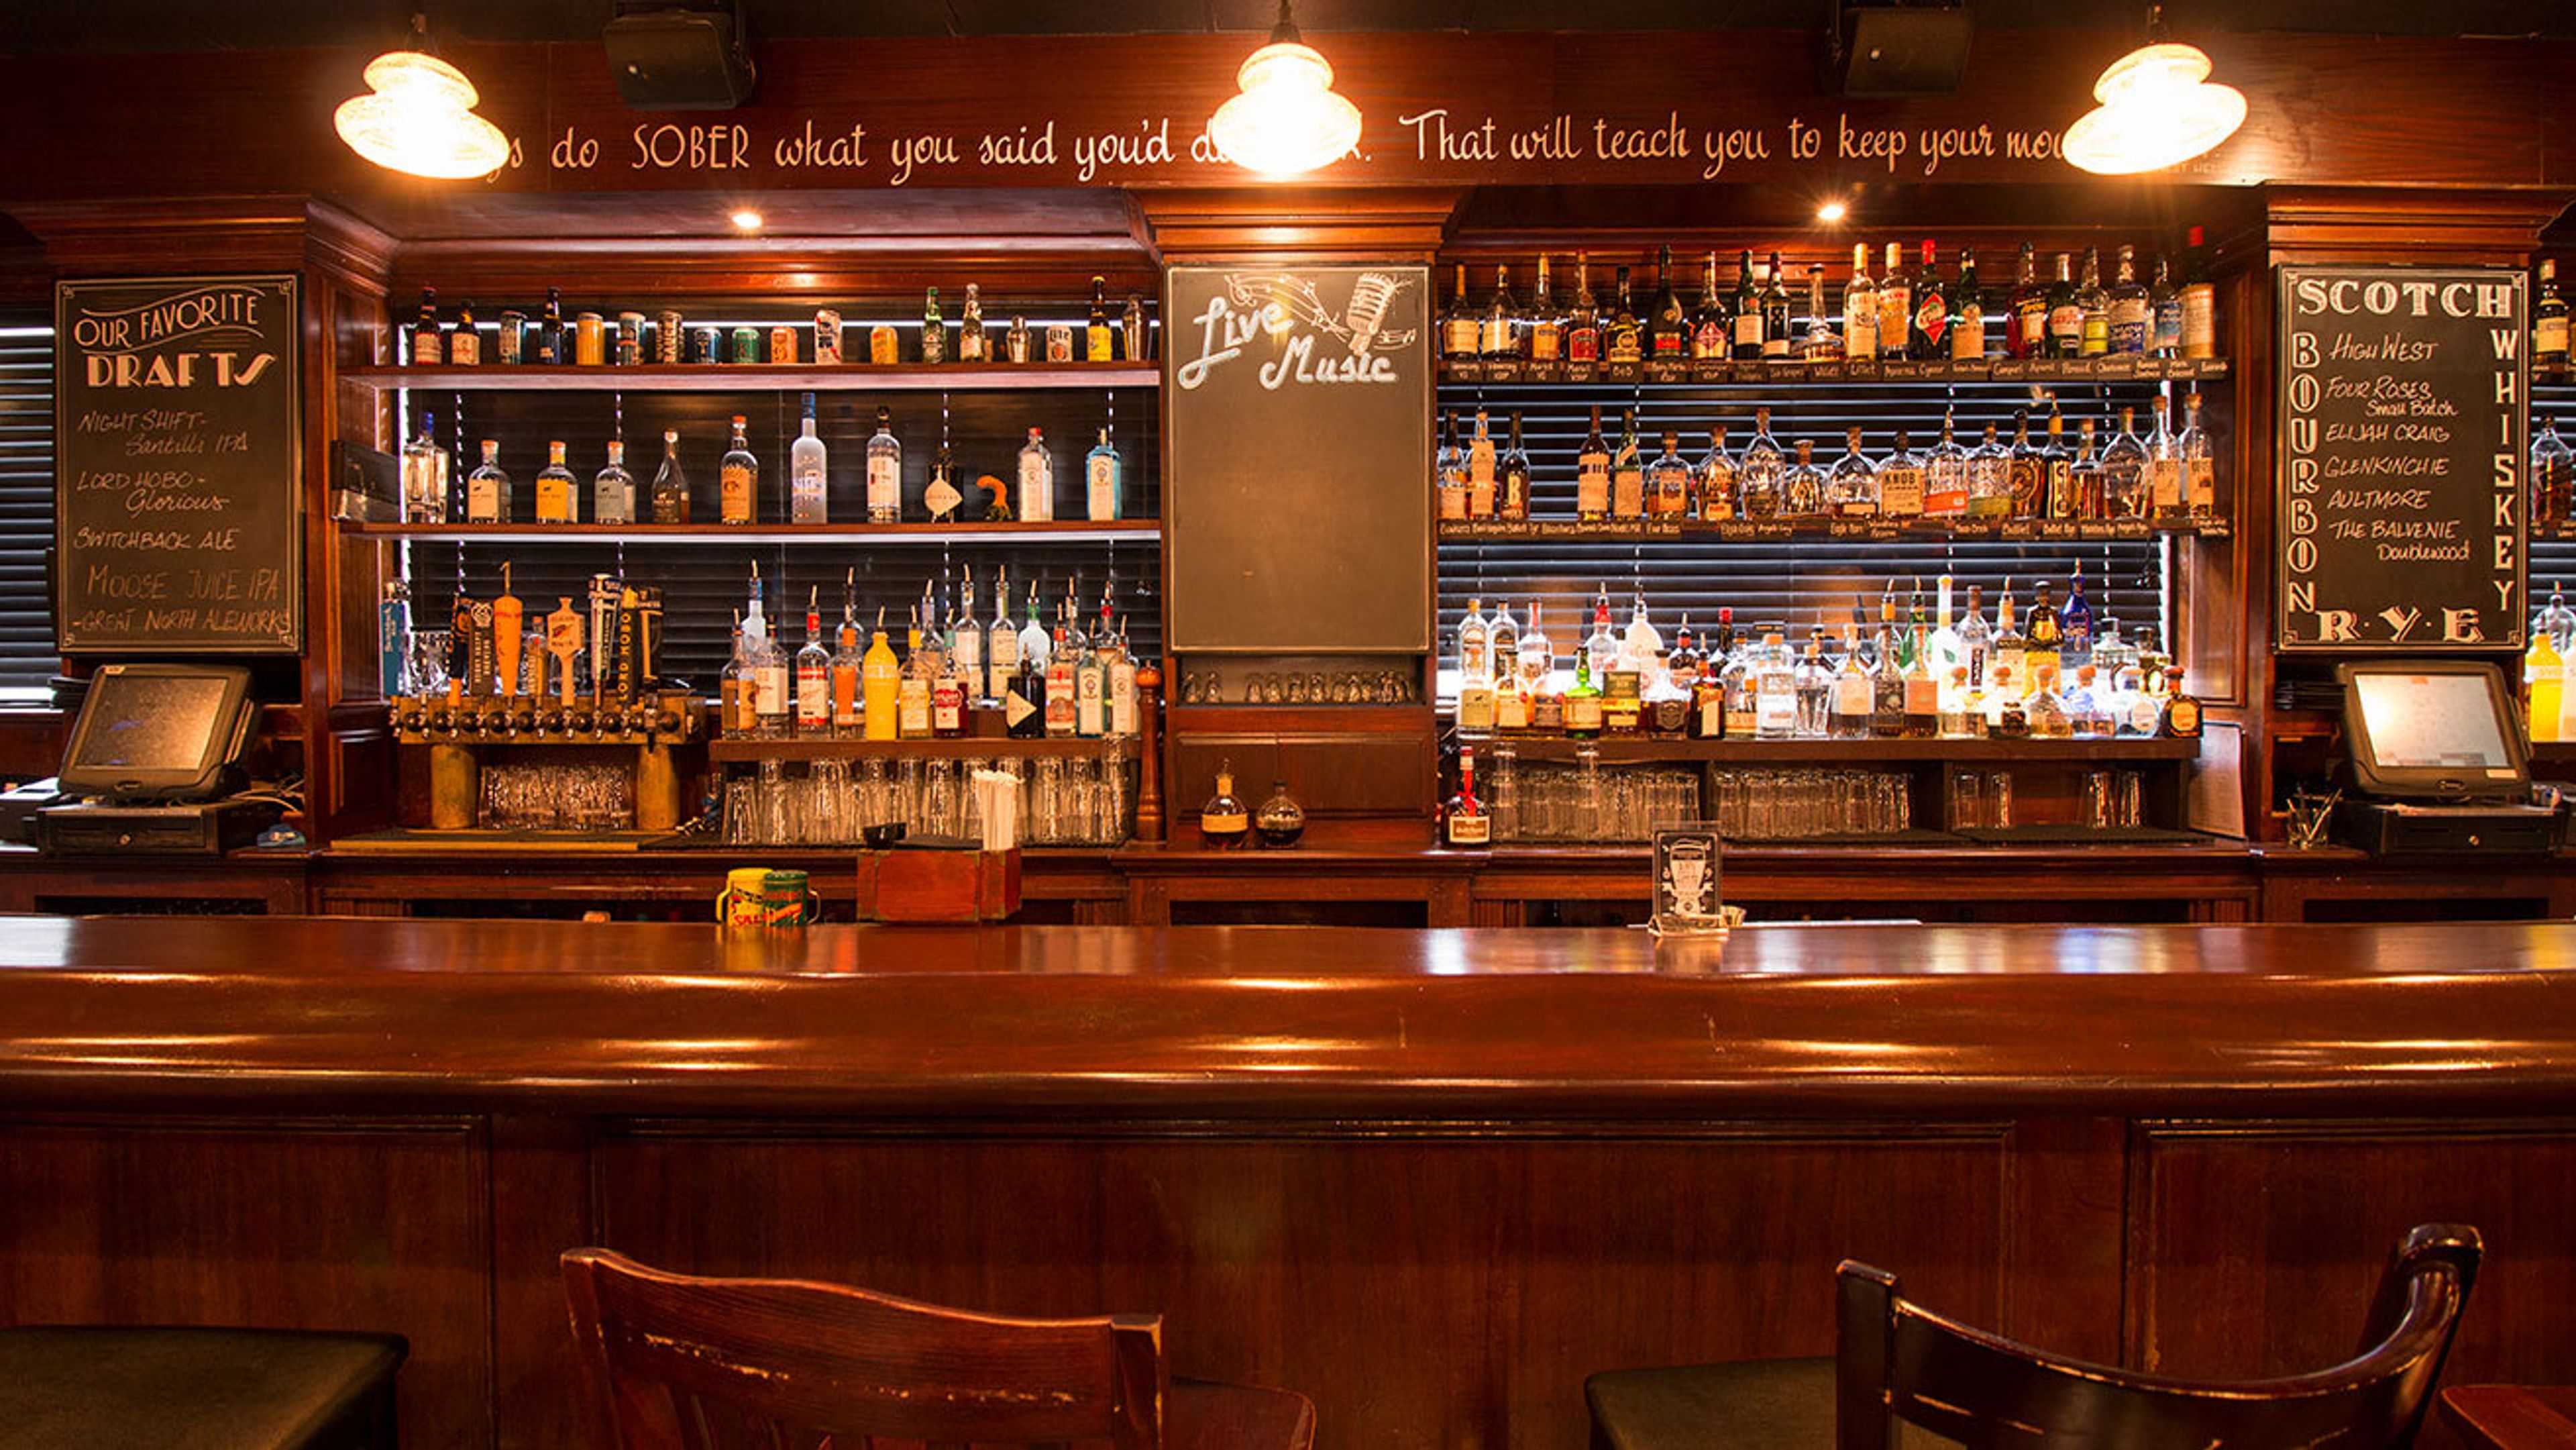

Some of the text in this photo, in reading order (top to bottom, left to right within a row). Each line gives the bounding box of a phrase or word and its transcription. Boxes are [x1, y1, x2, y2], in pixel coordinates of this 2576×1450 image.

[551, 127, 598, 168] do
[632, 124, 749, 168] SOBER
[775, 120, 868, 167] what
[890, 136, 960, 186] you
[979, 121, 1058, 165] said
[1075, 117, 1176, 182] you'd
[1399, 110, 1499, 160] That
[1510, 115, 1582, 160] will
[1594, 111, 1689, 160] teach
[1703, 130, 1769, 179] you
[1788, 117, 1821, 159] to
[1839, 113, 1906, 172] keep
[1921, 124, 1995, 176] your
[2298, 278, 2513, 318] SCOTCH
[74, 294, 258, 348] OUR FAVORITE
[1177, 297, 1295, 390] Live
[2329, 332, 2439, 362] HIGH WEST
[87, 352, 277, 387] DRAFTS
[1259, 334, 1398, 390] Music
[2324, 375, 2433, 401] FOUR ROSES
[77, 411, 137, 433] NIGHT
[2365, 399, 2459, 417] Small Batch
[2324, 423, 2451, 444] ELIJAH CRAIG
[2288, 331, 2321, 613] BOURBON
[2323, 455, 2451, 478] GLENKINCHIE
[2490, 329, 2519, 611] WHISKEY
[76, 471, 130, 492] LORD
[125, 488, 231, 519] Glorious
[2327, 489, 2432, 510] AULTMORE
[72, 525, 241, 552] SWITCHBACK ALE
[2328, 519, 2461, 539] THE BALVENIE
[2376, 539, 2471, 561] Doublewood
[87, 564, 280, 601] MOOSE JUICE IPA
[144, 609, 197, 632] NORTH
[203, 607, 291, 633] ALEWORKS
